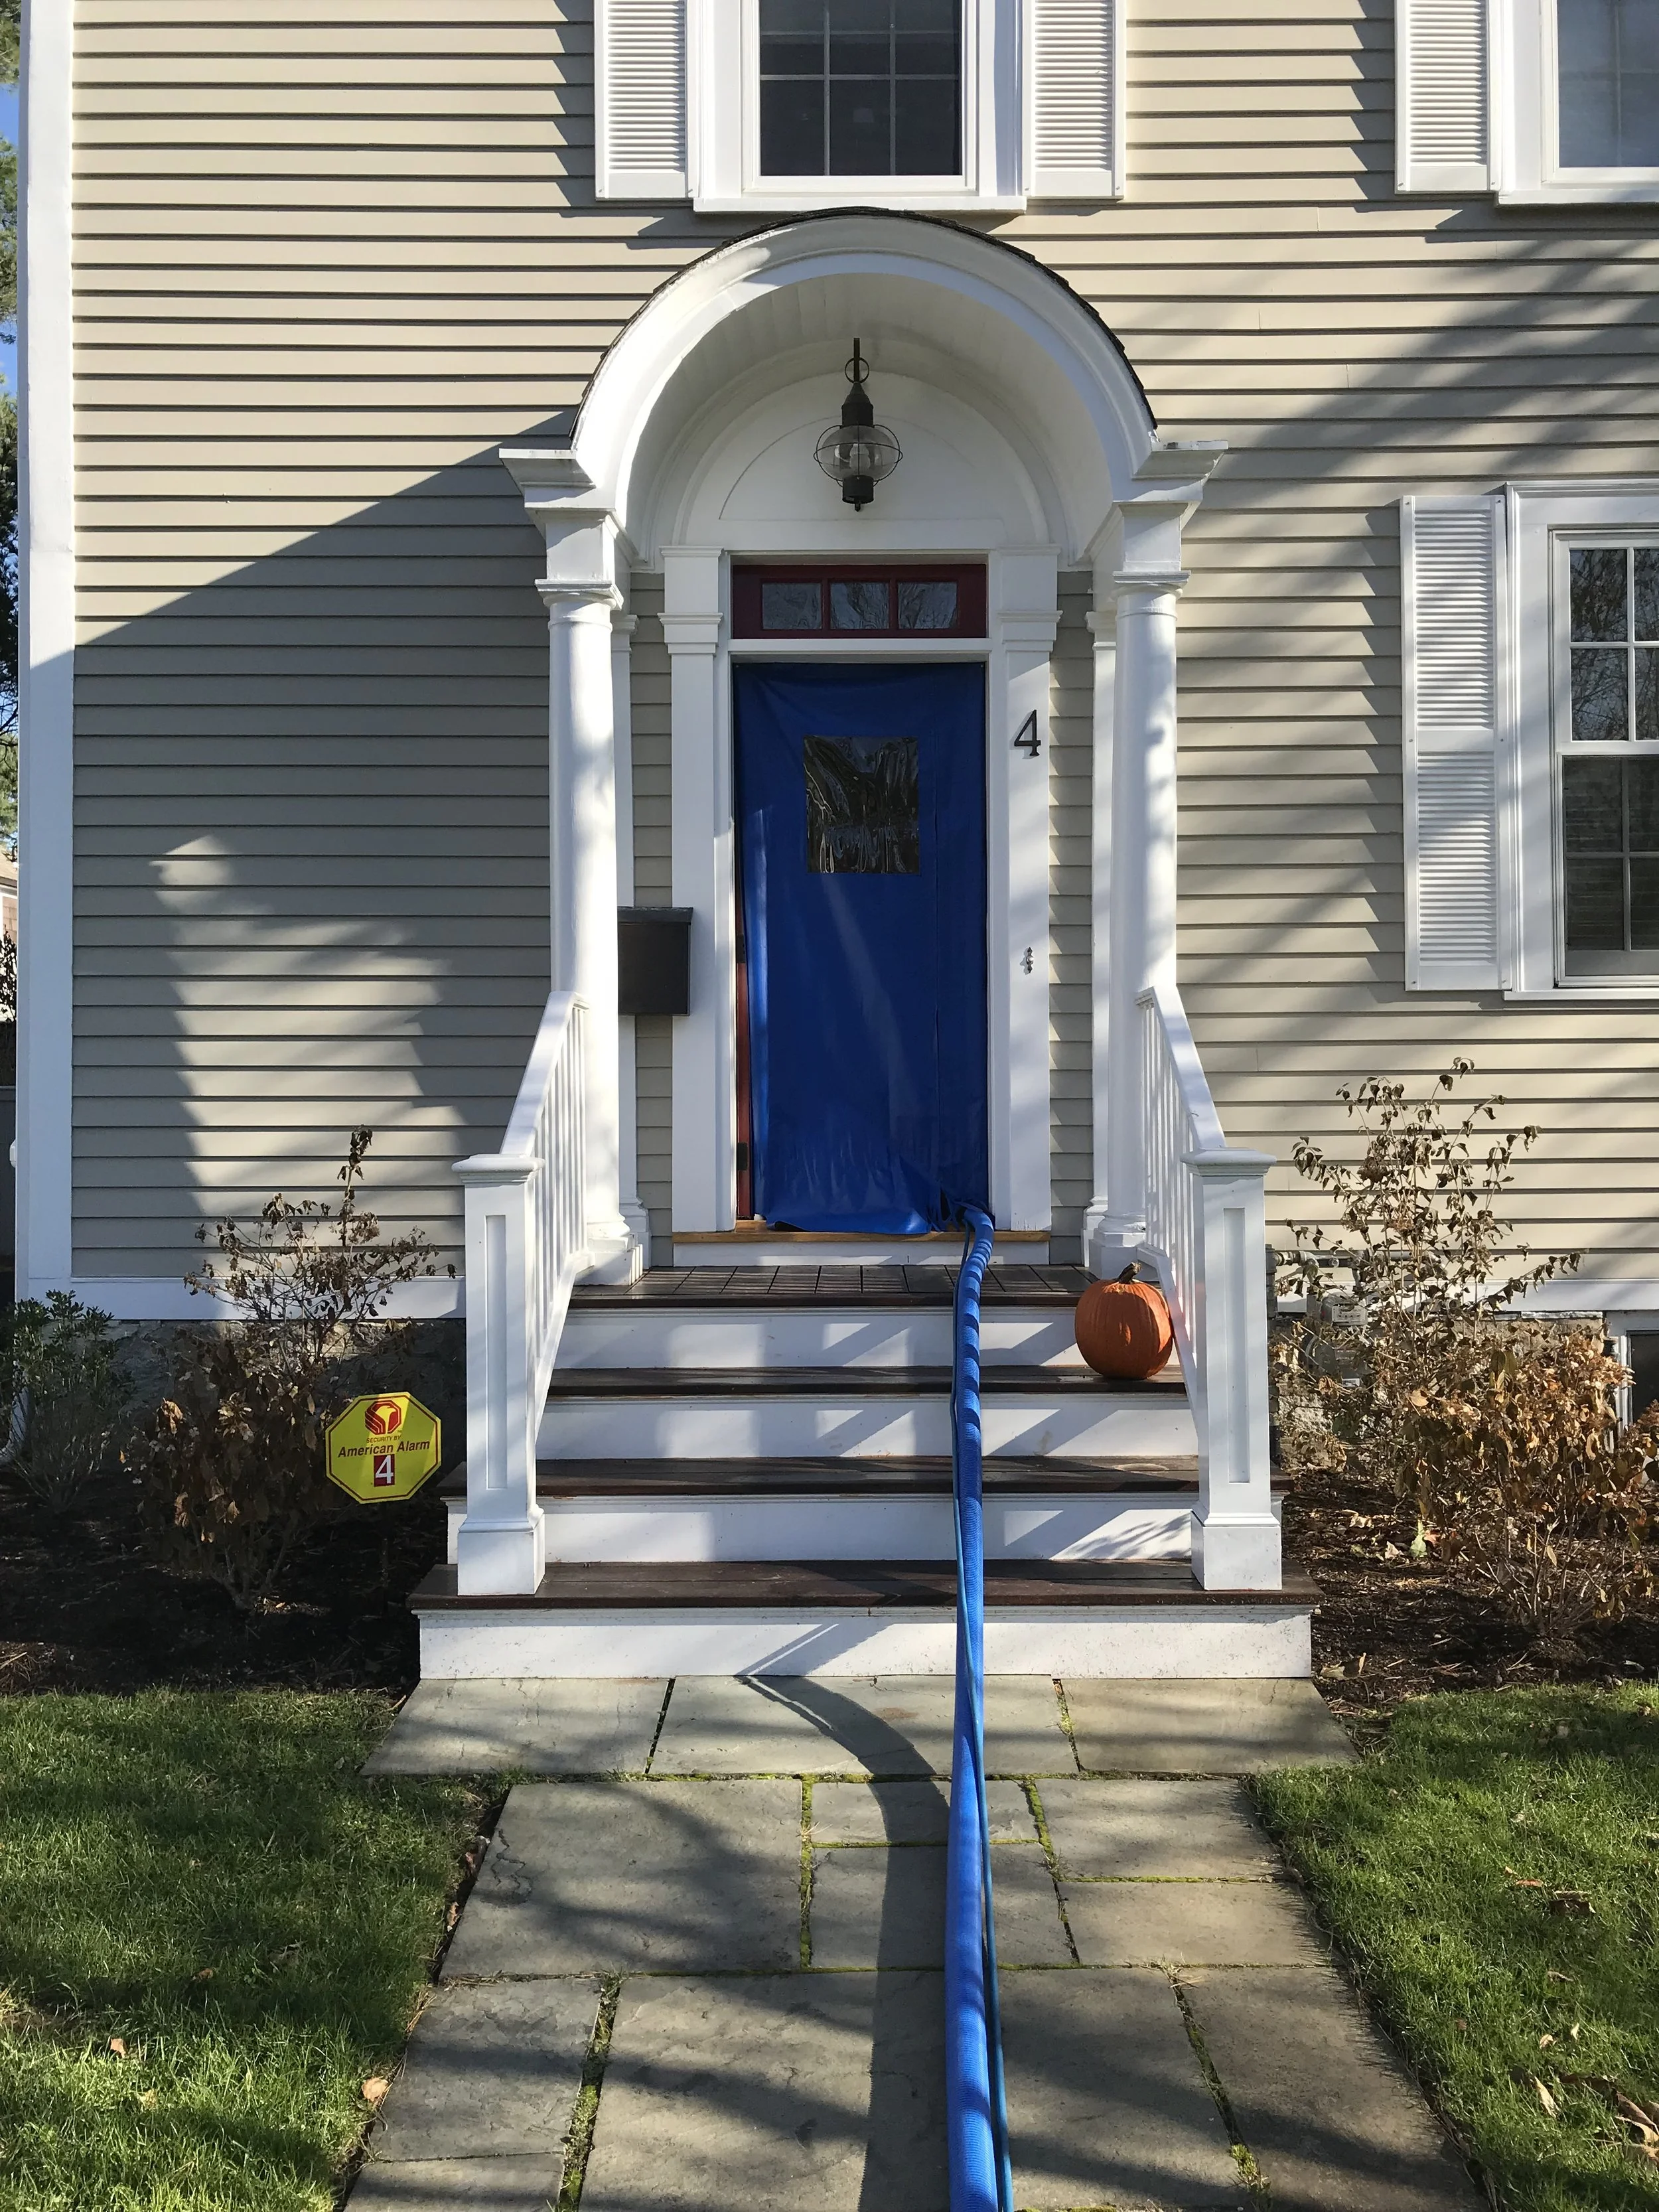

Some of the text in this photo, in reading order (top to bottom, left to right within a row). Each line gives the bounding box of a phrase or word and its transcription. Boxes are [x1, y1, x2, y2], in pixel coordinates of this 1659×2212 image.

[1014, 709, 1041, 756] 4
[338, 1440, 430, 1457] American Alarm
[375, 1455, 394, 1484] 4
